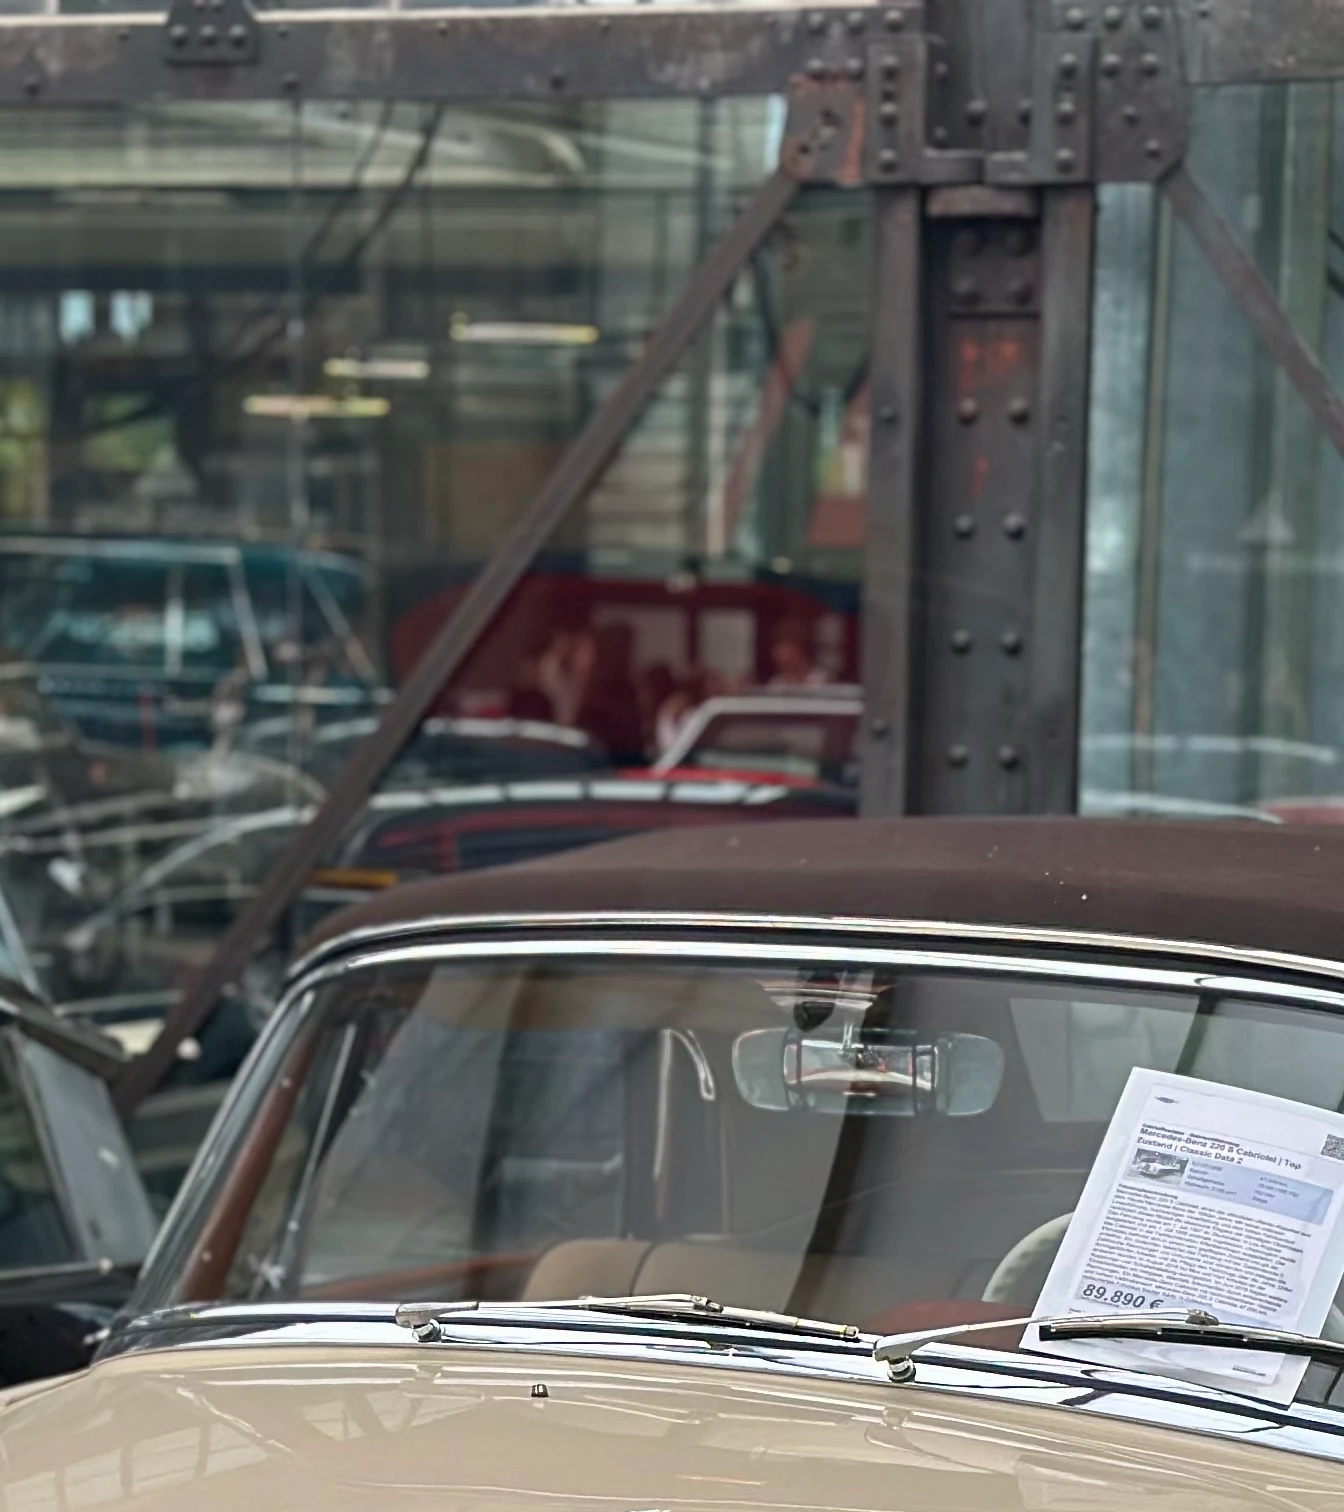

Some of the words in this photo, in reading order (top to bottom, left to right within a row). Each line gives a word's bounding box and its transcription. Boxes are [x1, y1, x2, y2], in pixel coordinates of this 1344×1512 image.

[1136, 1136, 1173, 1150] Zustand
[1179, 1145, 1213, 1158] Classic
[1214, 1151, 1236, 1163] Data
[1139, 1127, 1207, 1148] Mercedes-Benz
[1284, 1158, 1302, 1170] Top
[1082, 1283, 1146, 1309] 89.890
